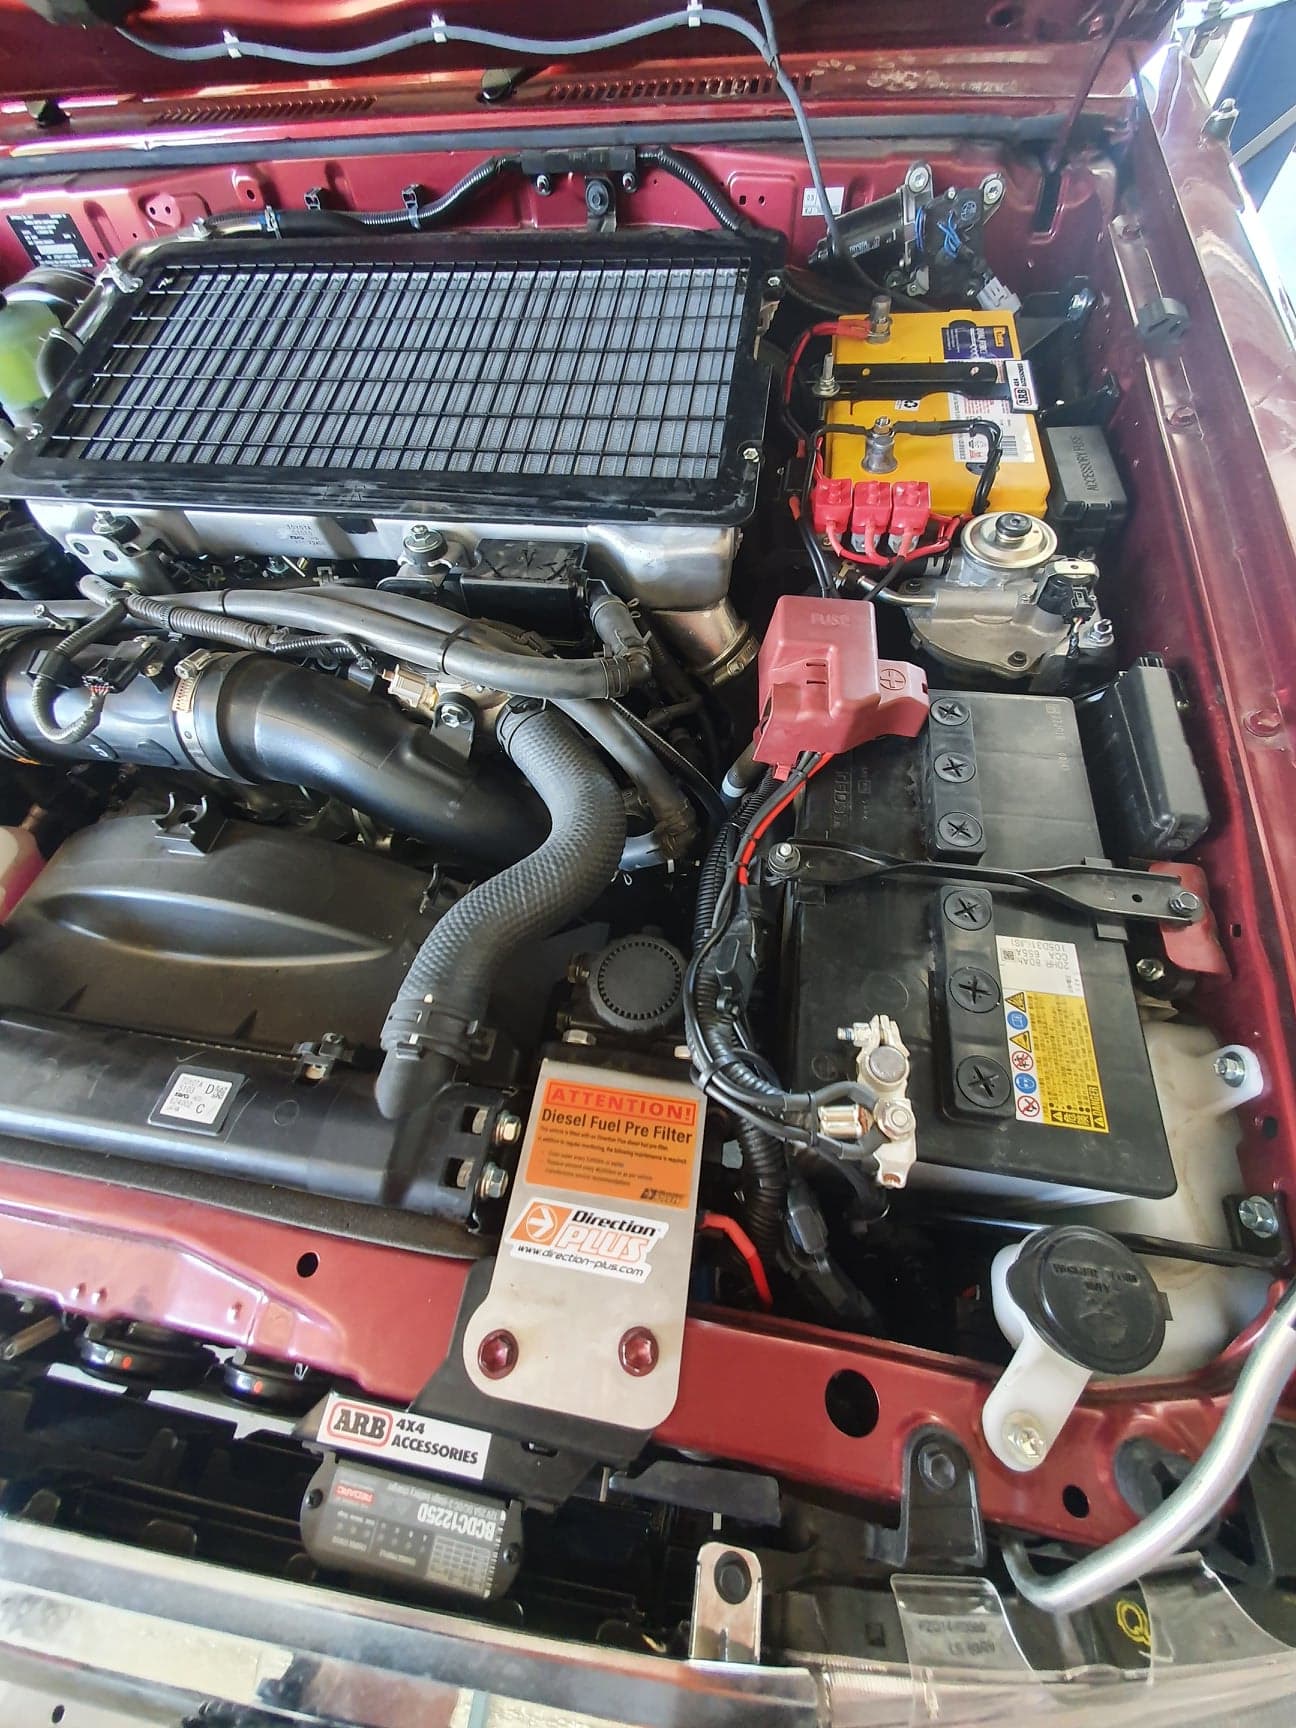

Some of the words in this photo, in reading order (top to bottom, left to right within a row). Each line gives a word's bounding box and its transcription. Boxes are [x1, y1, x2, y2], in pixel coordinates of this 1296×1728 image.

[1016, 387, 1030, 405] ARB
[1076, 452, 1099, 491] ACCESSORY
[1048, 951, 1069, 962] CCA
[195, 1103, 206, 1114] C
[550, 1087, 692, 1121] ATTENTION!
[541, 1107, 586, 1128] Diesel
[589, 1115, 621, 1134] Fuel
[624, 1121, 648, 1137] Pre
[653, 1125, 693, 1144] Filter
[571, 1209, 657, 1238] Direction
[554, 1222, 650, 1264] PLUS
[517, 1245, 645, 1277] www.direction-plus.com
[333, 1408, 387, 1440] ARB
[391, 1435, 479, 1465] ACCESSORIES
